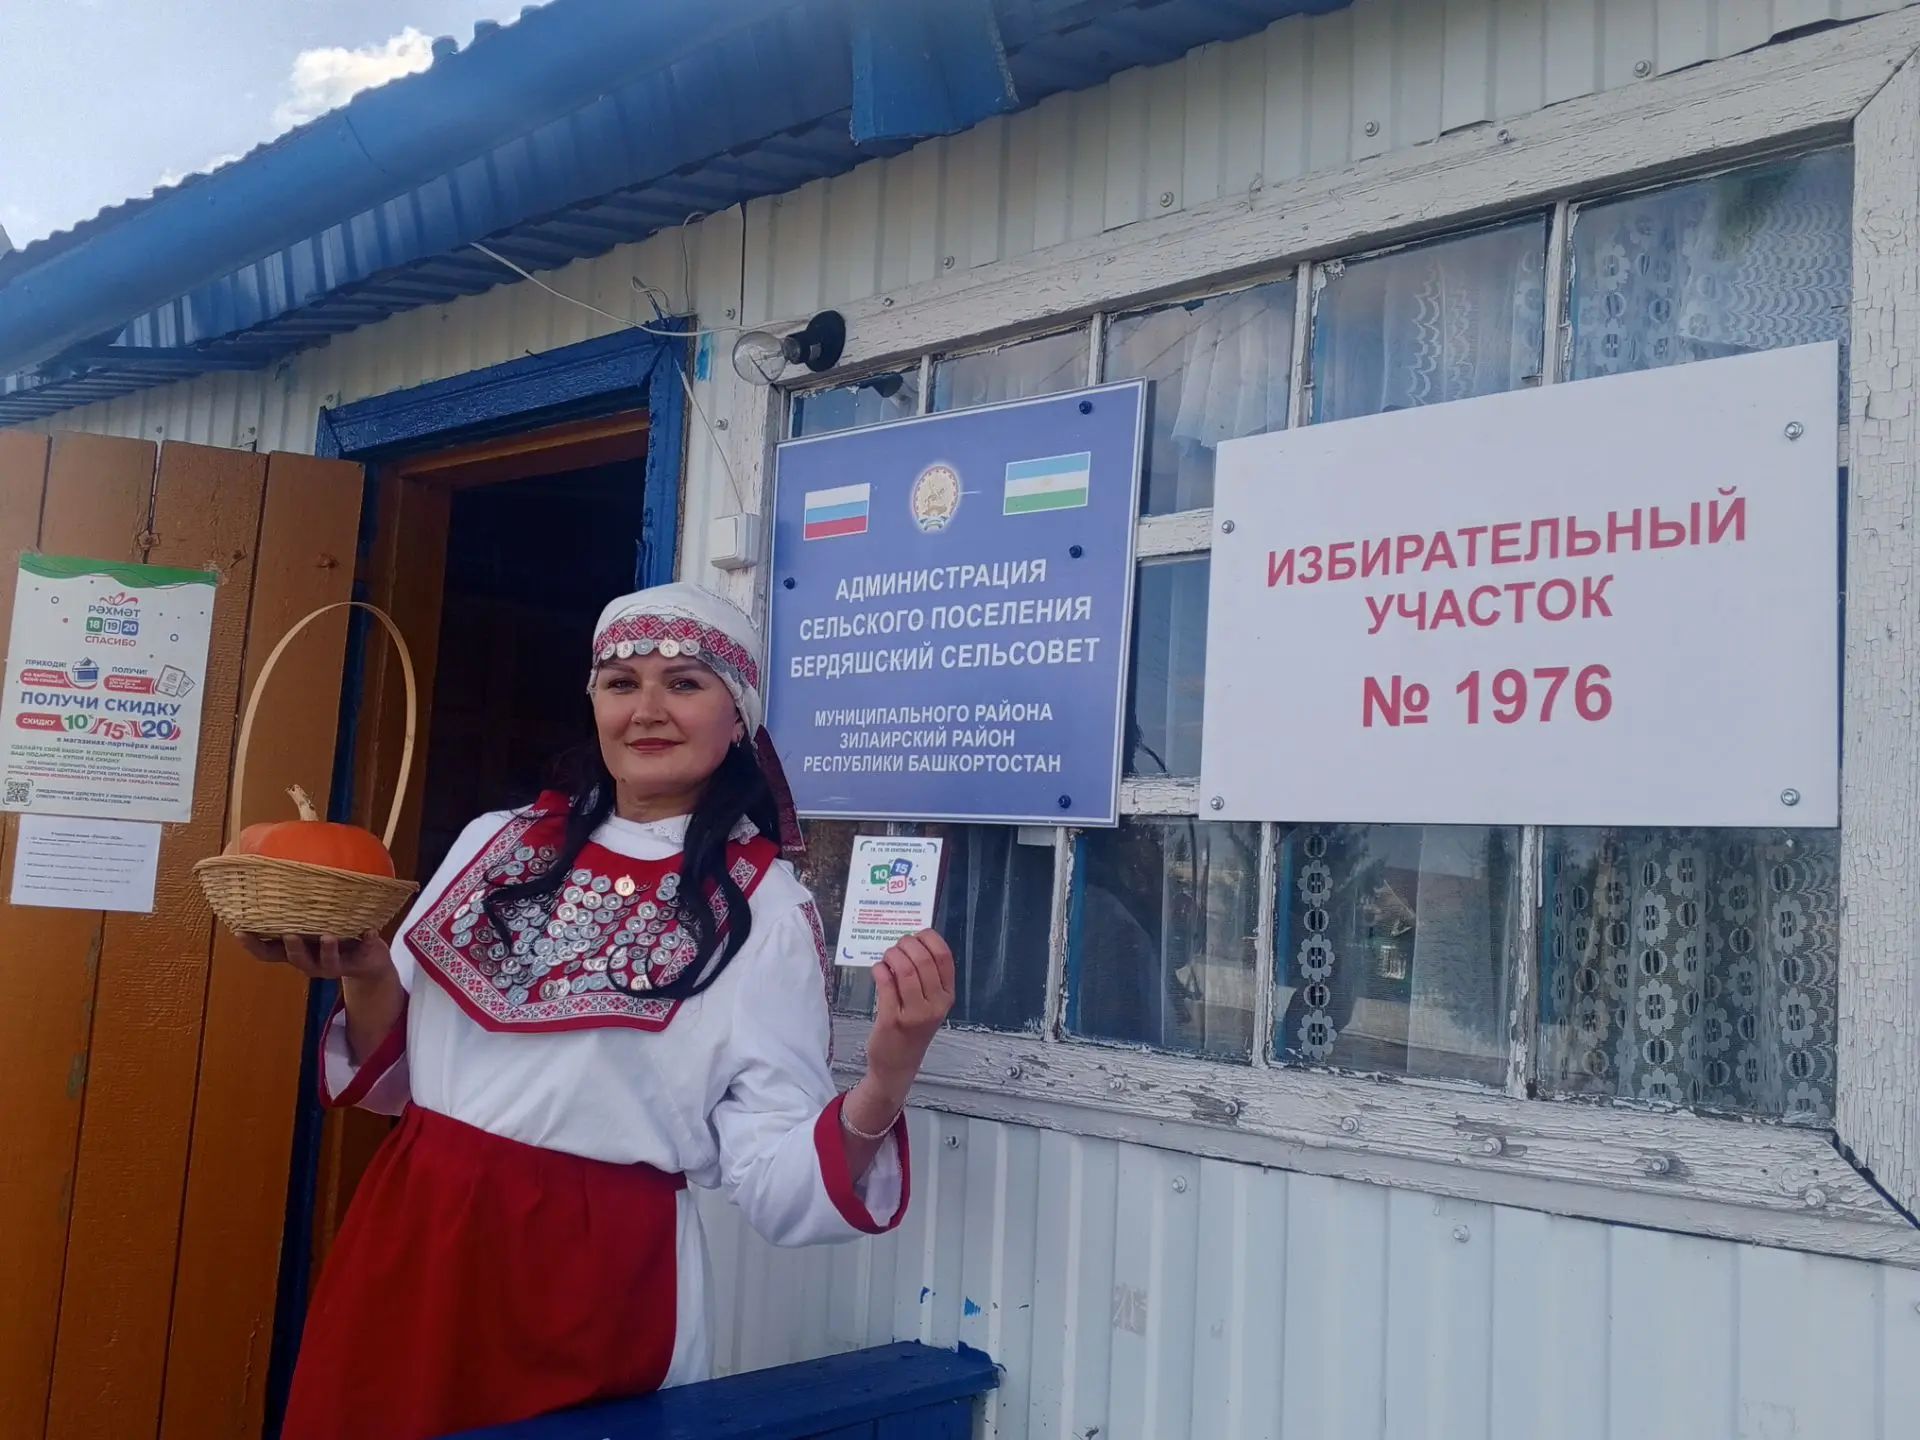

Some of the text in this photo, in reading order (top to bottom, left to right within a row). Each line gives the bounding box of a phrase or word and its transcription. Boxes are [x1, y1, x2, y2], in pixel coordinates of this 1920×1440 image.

[1266, 485, 1746, 588] ИЗБИРАТЕЛЬНЫЙ
[835, 558, 1048, 604] АДМИНИСТРАЦИЯ
[1365, 573, 1615, 635] УЧАСТОК
[89, 619, 137, 632] 18 19 20
[799, 596, 1092, 641] СЕЛЬСКОГО ПОСЕЛЕНИЯ
[85, 635, 137, 647] СПАСИБО
[790, 637, 1100, 680] БЕРДЯШСКИЙ СЕЛЬСОВЕТ
[21, 691, 182, 717] ПОЛУЧИ СКИДКУ
[1361, 664, 1613, 728] № 1976
[815, 699, 1054, 728] МУНИЦИПАЛЬНОГО РАЙОНА
[839, 725, 1016, 749] ЗИЛАИРСКИЙ РАЙОН
[803, 754, 1062, 774] РЕСПУБЛИКИ БАШКОРТОСТАН
[873, 869, 887, 879] 10
[895, 863, 908, 873] 15
[891, 880, 903, 889] 20
